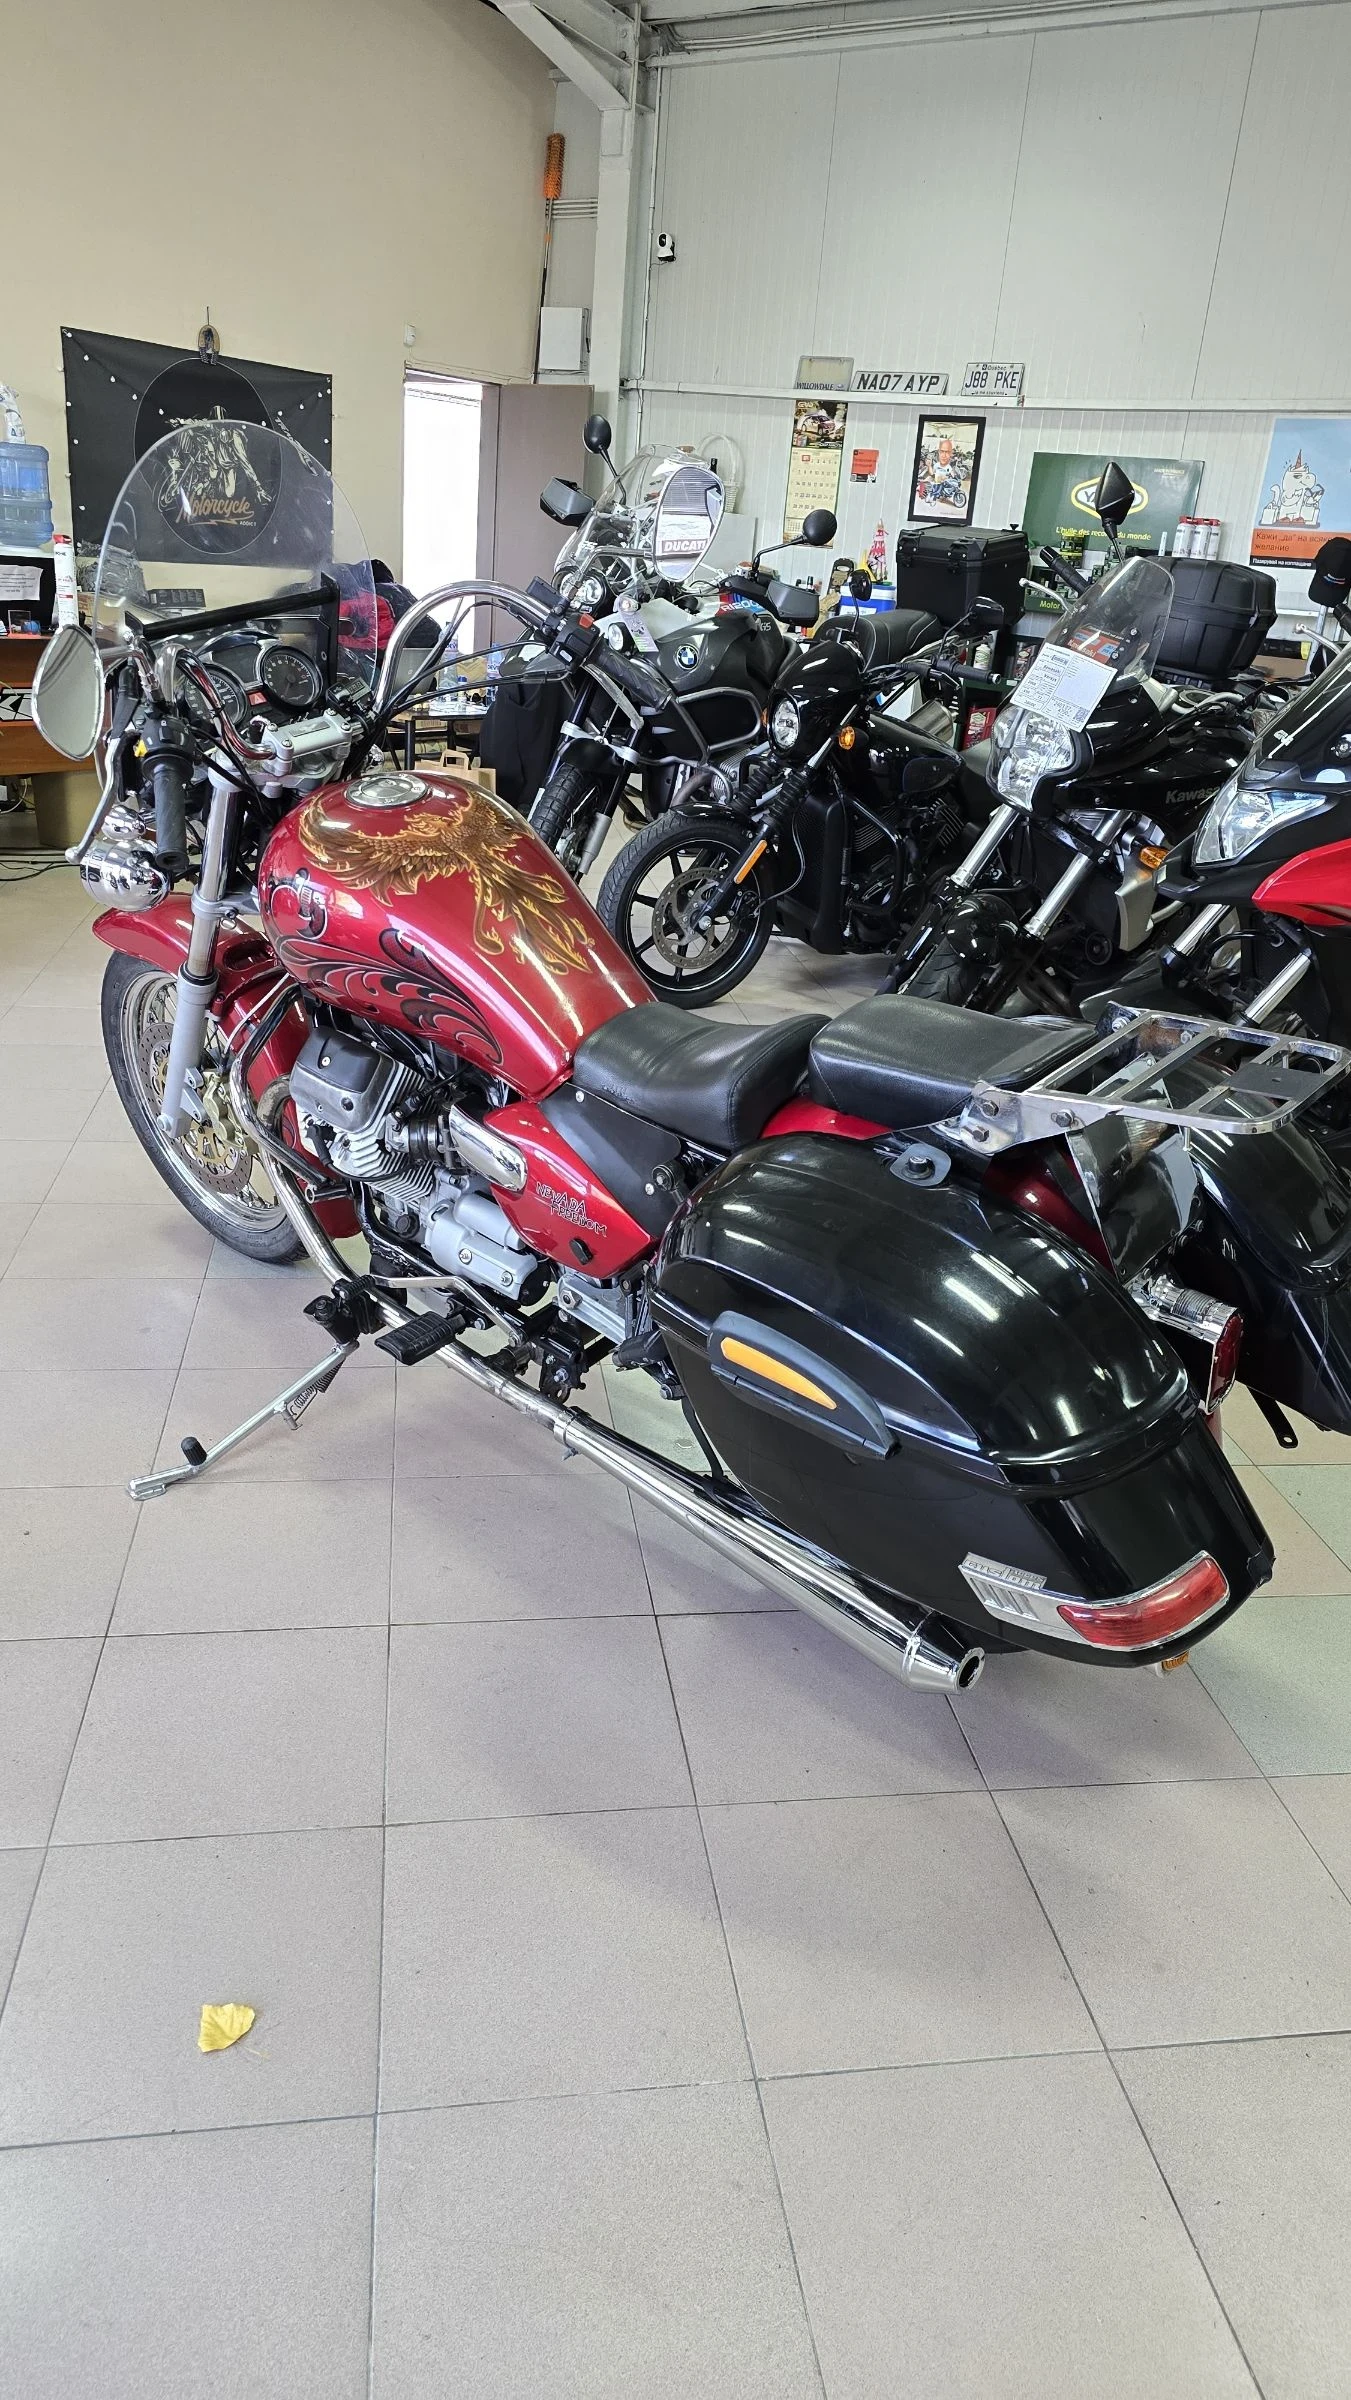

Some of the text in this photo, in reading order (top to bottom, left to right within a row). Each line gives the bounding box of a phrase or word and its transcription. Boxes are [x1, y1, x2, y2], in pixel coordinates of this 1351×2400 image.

[797, 382, 834, 390] WILLOWDALE
[857, 373, 940, 392] NA07 AYP
[965, 371, 1019, 389] J88 PKE
[1056, 526, 1077, 535] L'huile
[1078, 528, 1090, 536] des
[1127, 533, 1151, 541] monde
[1256, 532, 1278, 541] Кажи
[664, 540, 706, 552] DUCATI
[1255, 543, 1290, 551] желание
[1040, 600, 1060, 609] Motor
[536, 1181, 586, 1217] NEVADA
[551, 1200, 607, 1237] FREEDOM
